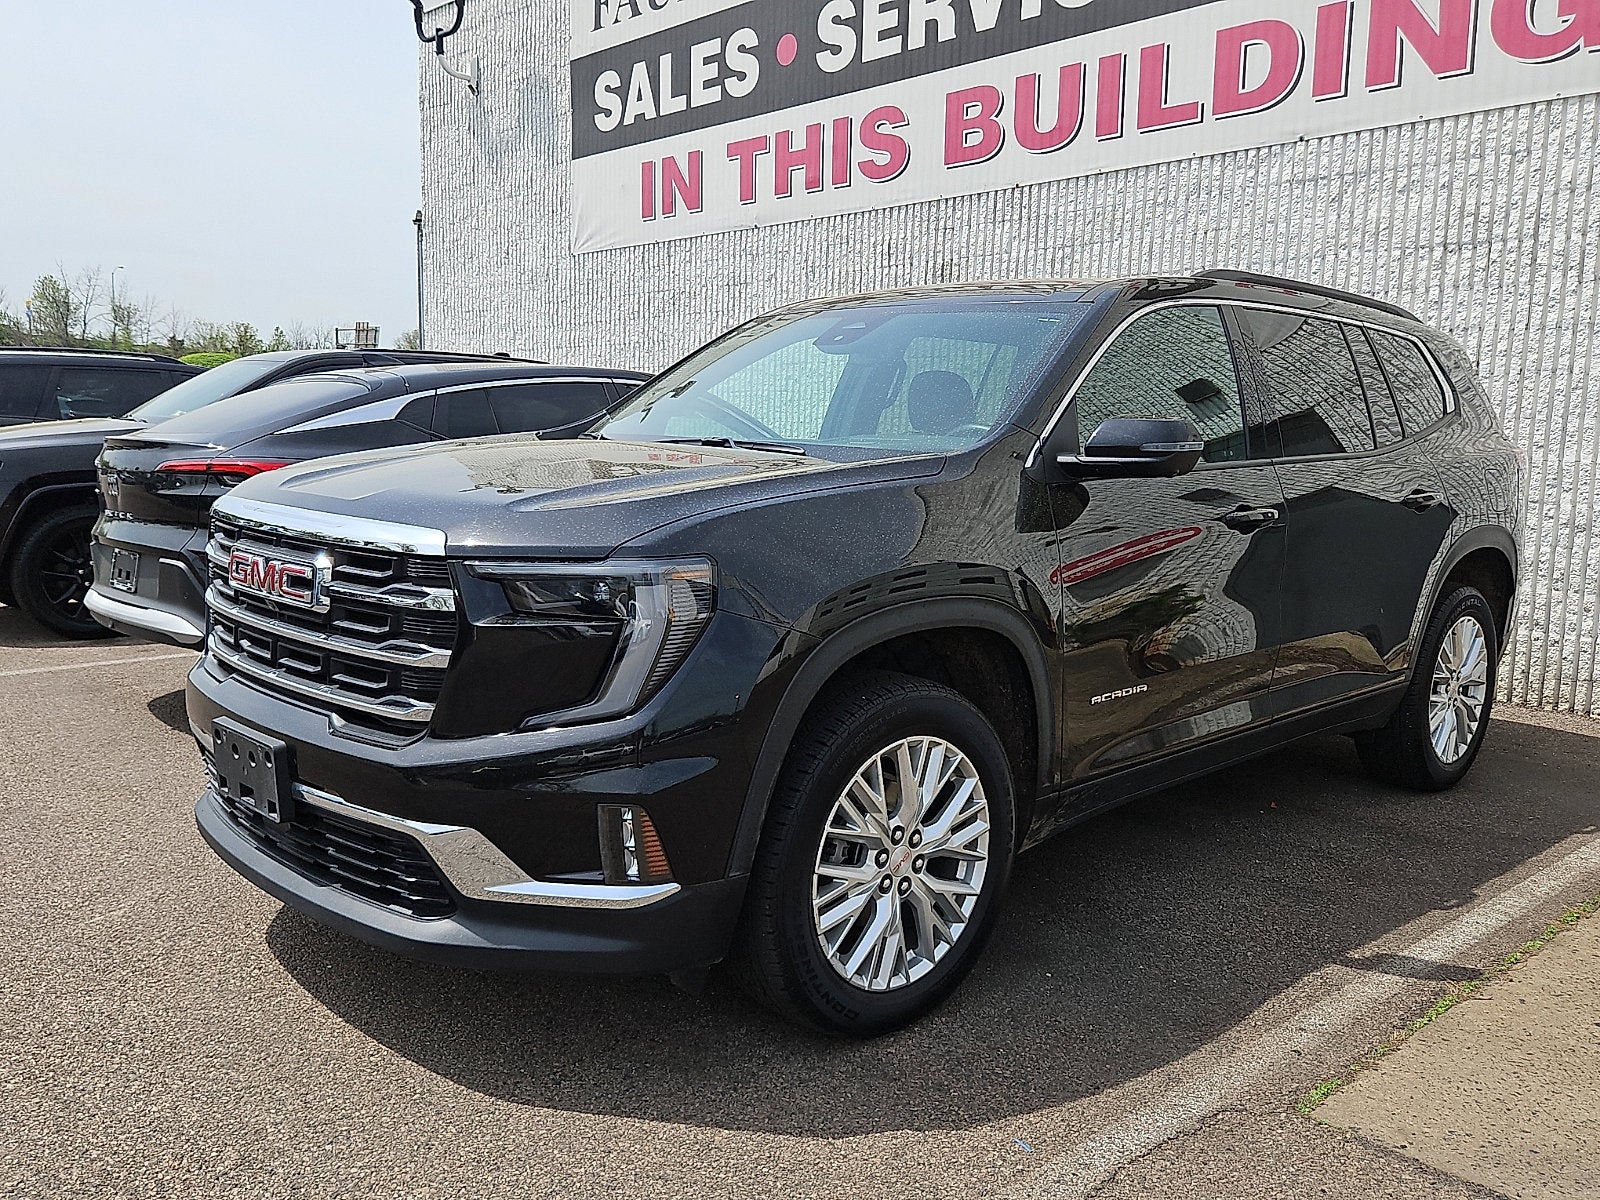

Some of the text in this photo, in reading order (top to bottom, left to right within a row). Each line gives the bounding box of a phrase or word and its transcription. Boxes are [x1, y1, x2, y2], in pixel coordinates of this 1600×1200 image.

[593, 0, 1094, 133] SALES SER
[640, 150, 703, 222] IN
[726, 105, 910, 200] THIS
[228, 551, 311, 602] GMC
[1090, 684, 1148, 705] ACADIA
